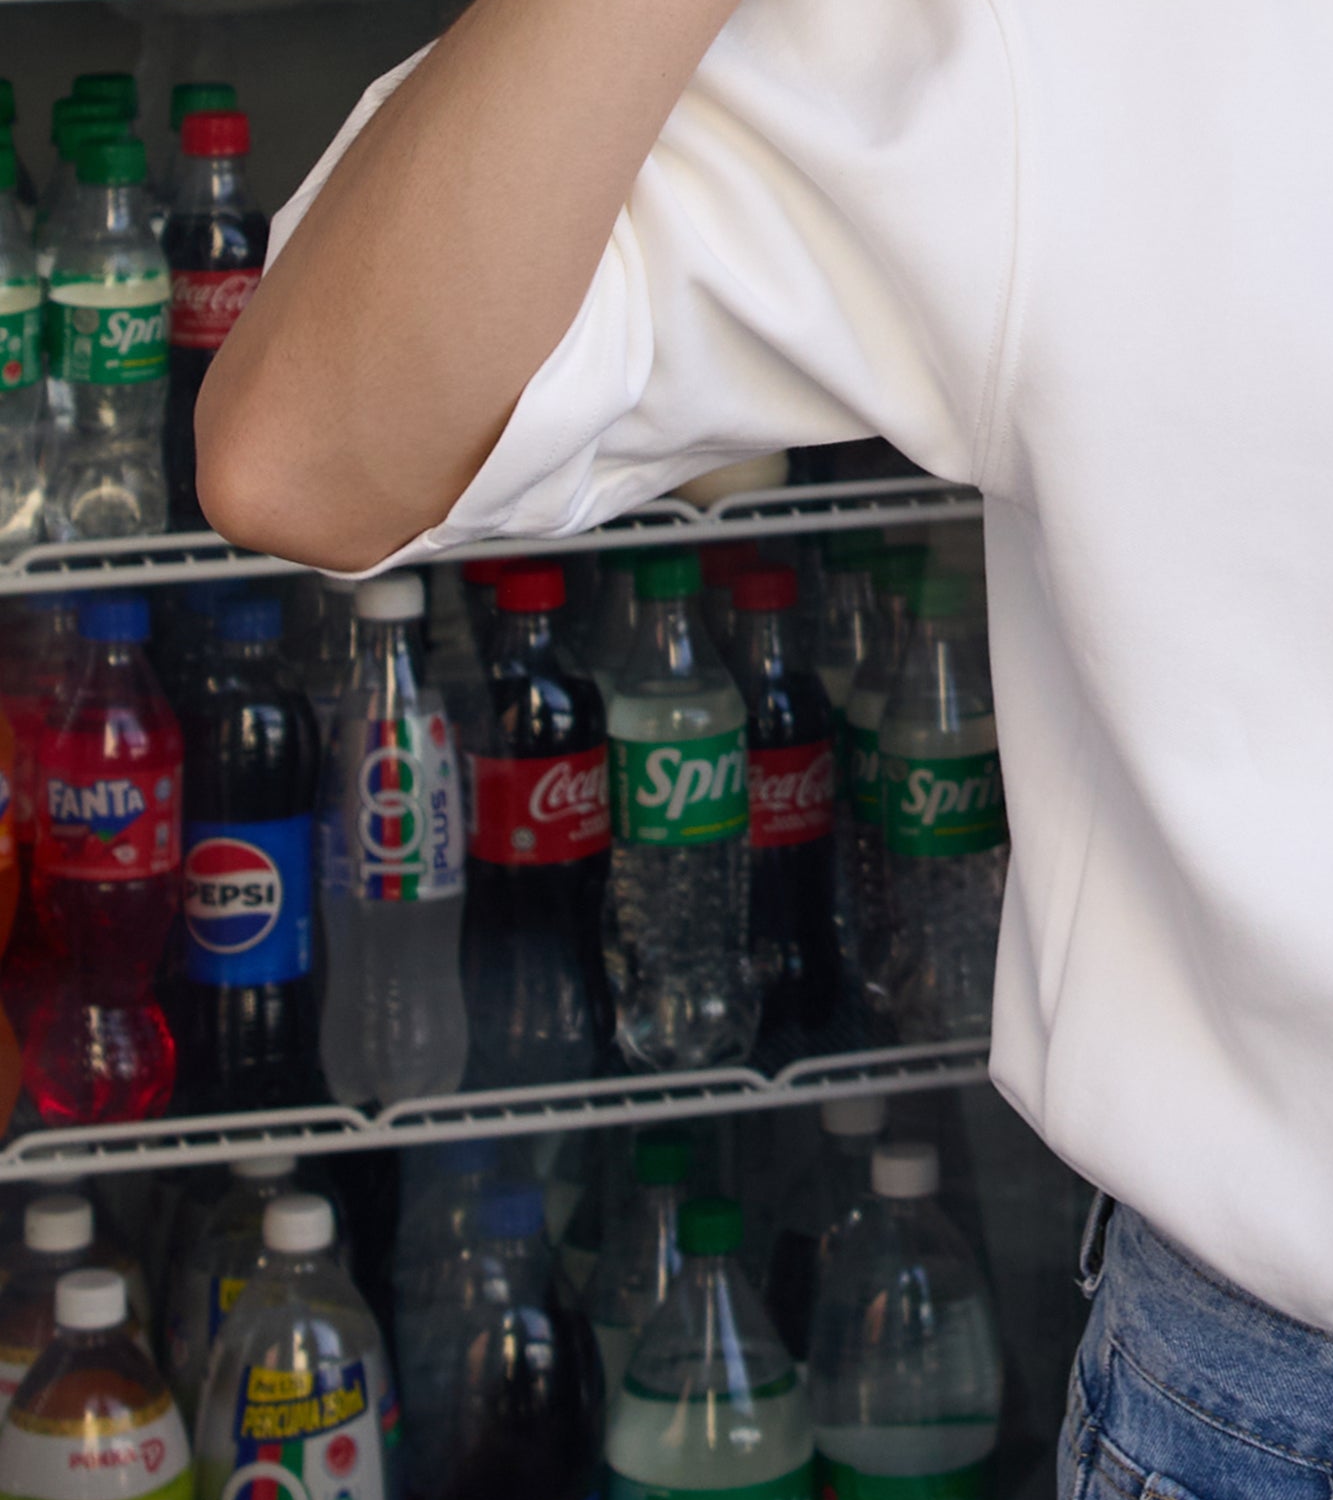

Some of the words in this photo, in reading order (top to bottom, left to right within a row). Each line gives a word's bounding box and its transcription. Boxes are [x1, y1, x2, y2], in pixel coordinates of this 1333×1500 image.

[99, 303, 166, 355] Spri
[634, 732, 749, 822] Spri
[901, 760, 1003, 826] Spri
